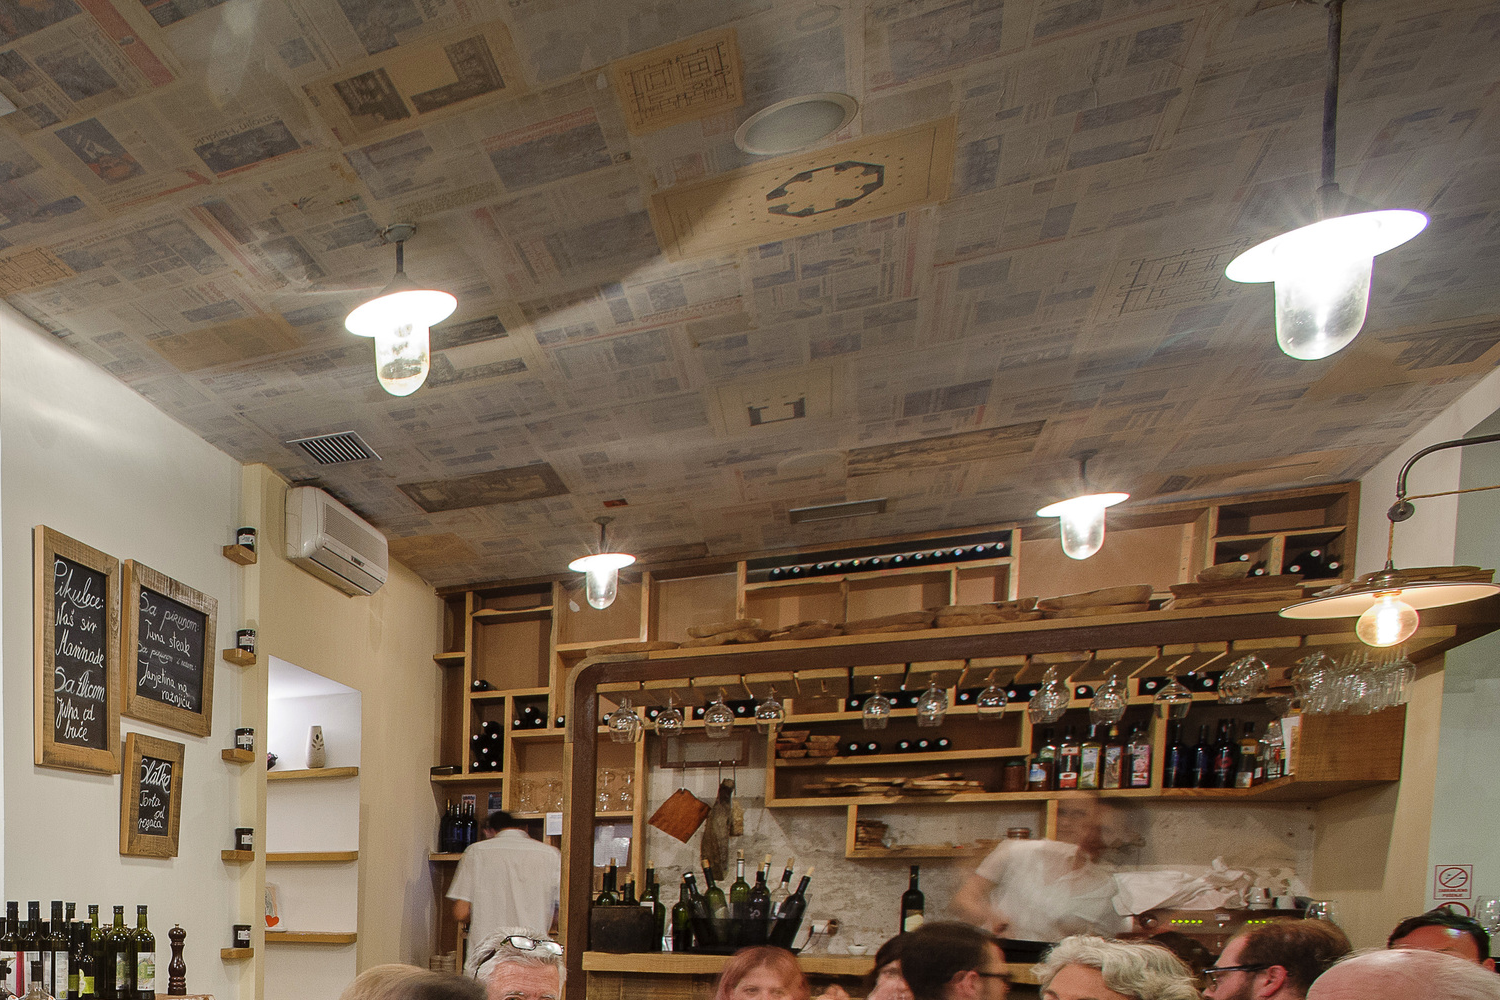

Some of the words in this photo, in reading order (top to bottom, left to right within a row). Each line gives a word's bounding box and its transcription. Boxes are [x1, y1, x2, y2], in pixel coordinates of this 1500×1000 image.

[55, 601, 74, 627] Naš
[80, 616, 97, 634] sir
[139, 592, 157, 616] Sa
[56, 628, 104, 668] Marinade
[145, 619, 165, 645] Tuna
[169, 631, 190, 657] steak
[54, 666, 75, 693] Sa
[139, 659, 175, 689] Janjetina
[178, 682, 188, 694] na
[56, 696, 79, 729] Juha
[83, 703, 95, 721] od
[141, 758, 171, 793] Slatko
[140, 789, 161, 807] Torta
[154, 805, 165, 820] od
